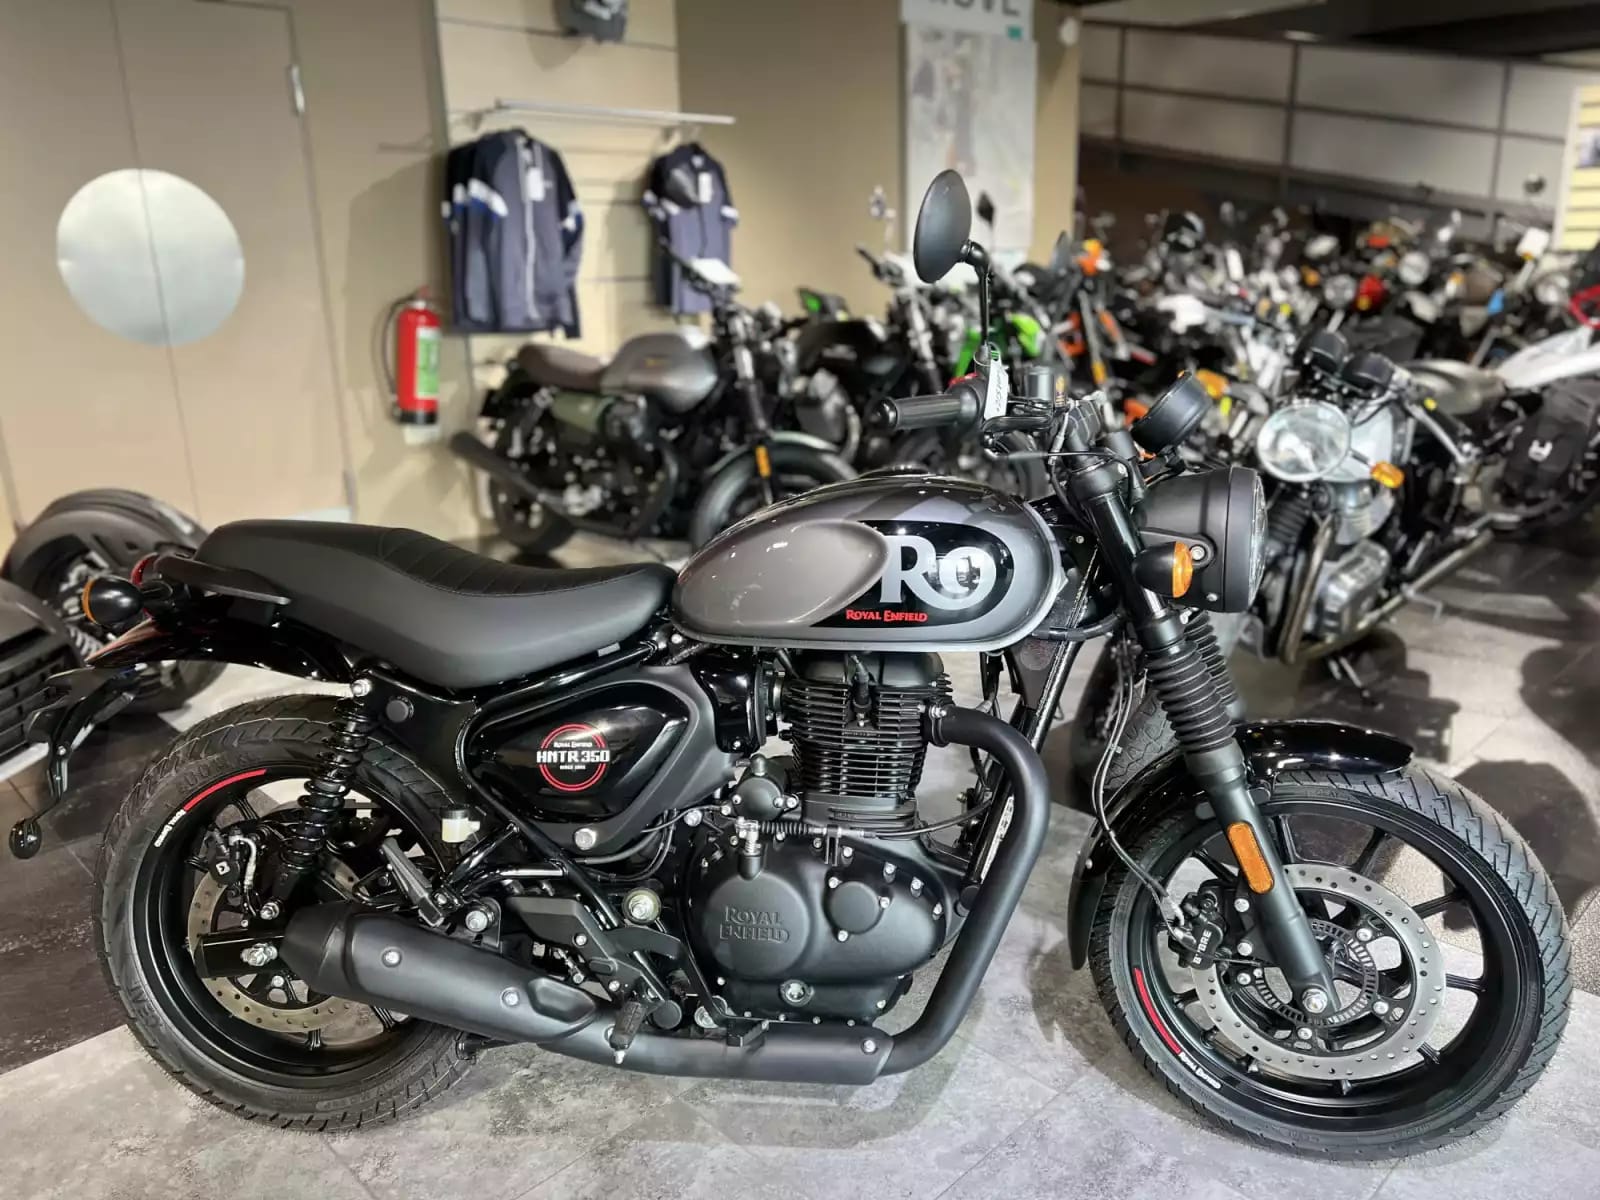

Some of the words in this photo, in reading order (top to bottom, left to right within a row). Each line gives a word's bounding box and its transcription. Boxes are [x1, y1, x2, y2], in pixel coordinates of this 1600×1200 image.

[845, 609, 882, 621] ROYAL
[883, 609, 928, 622] ENFIELD
[724, 906, 783, 926] ROYAL
[719, 923, 790, 944] ENFIELD
